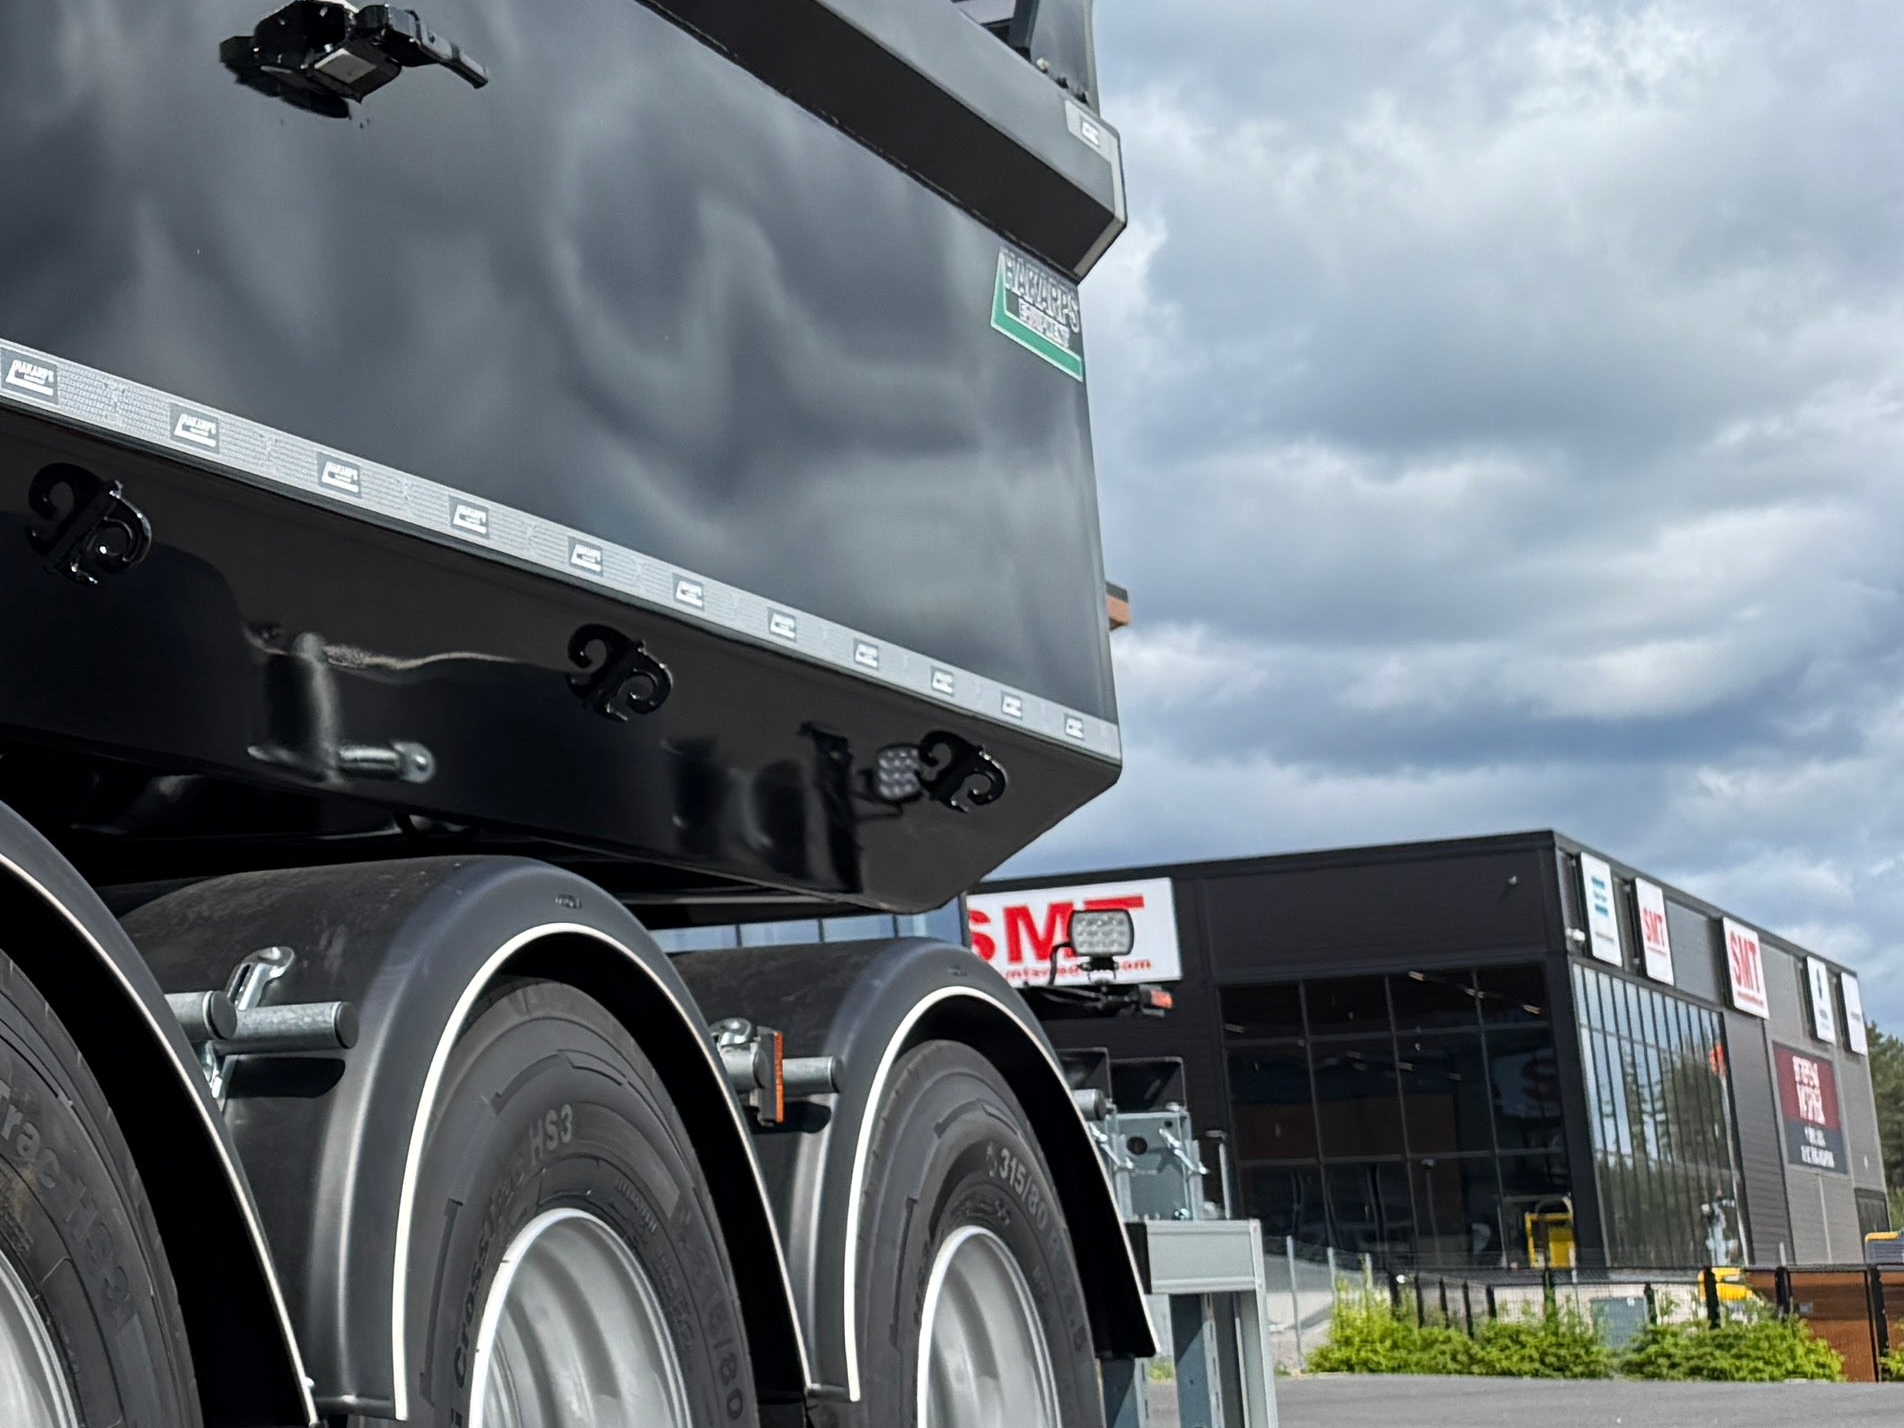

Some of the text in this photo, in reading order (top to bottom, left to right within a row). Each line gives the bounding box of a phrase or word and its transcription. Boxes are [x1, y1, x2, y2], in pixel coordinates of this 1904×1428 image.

[1730, 930, 1761, 995] SMT
[528, 1102, 574, 1160] HS3
[998, 1147, 1050, 1231] 315/80
